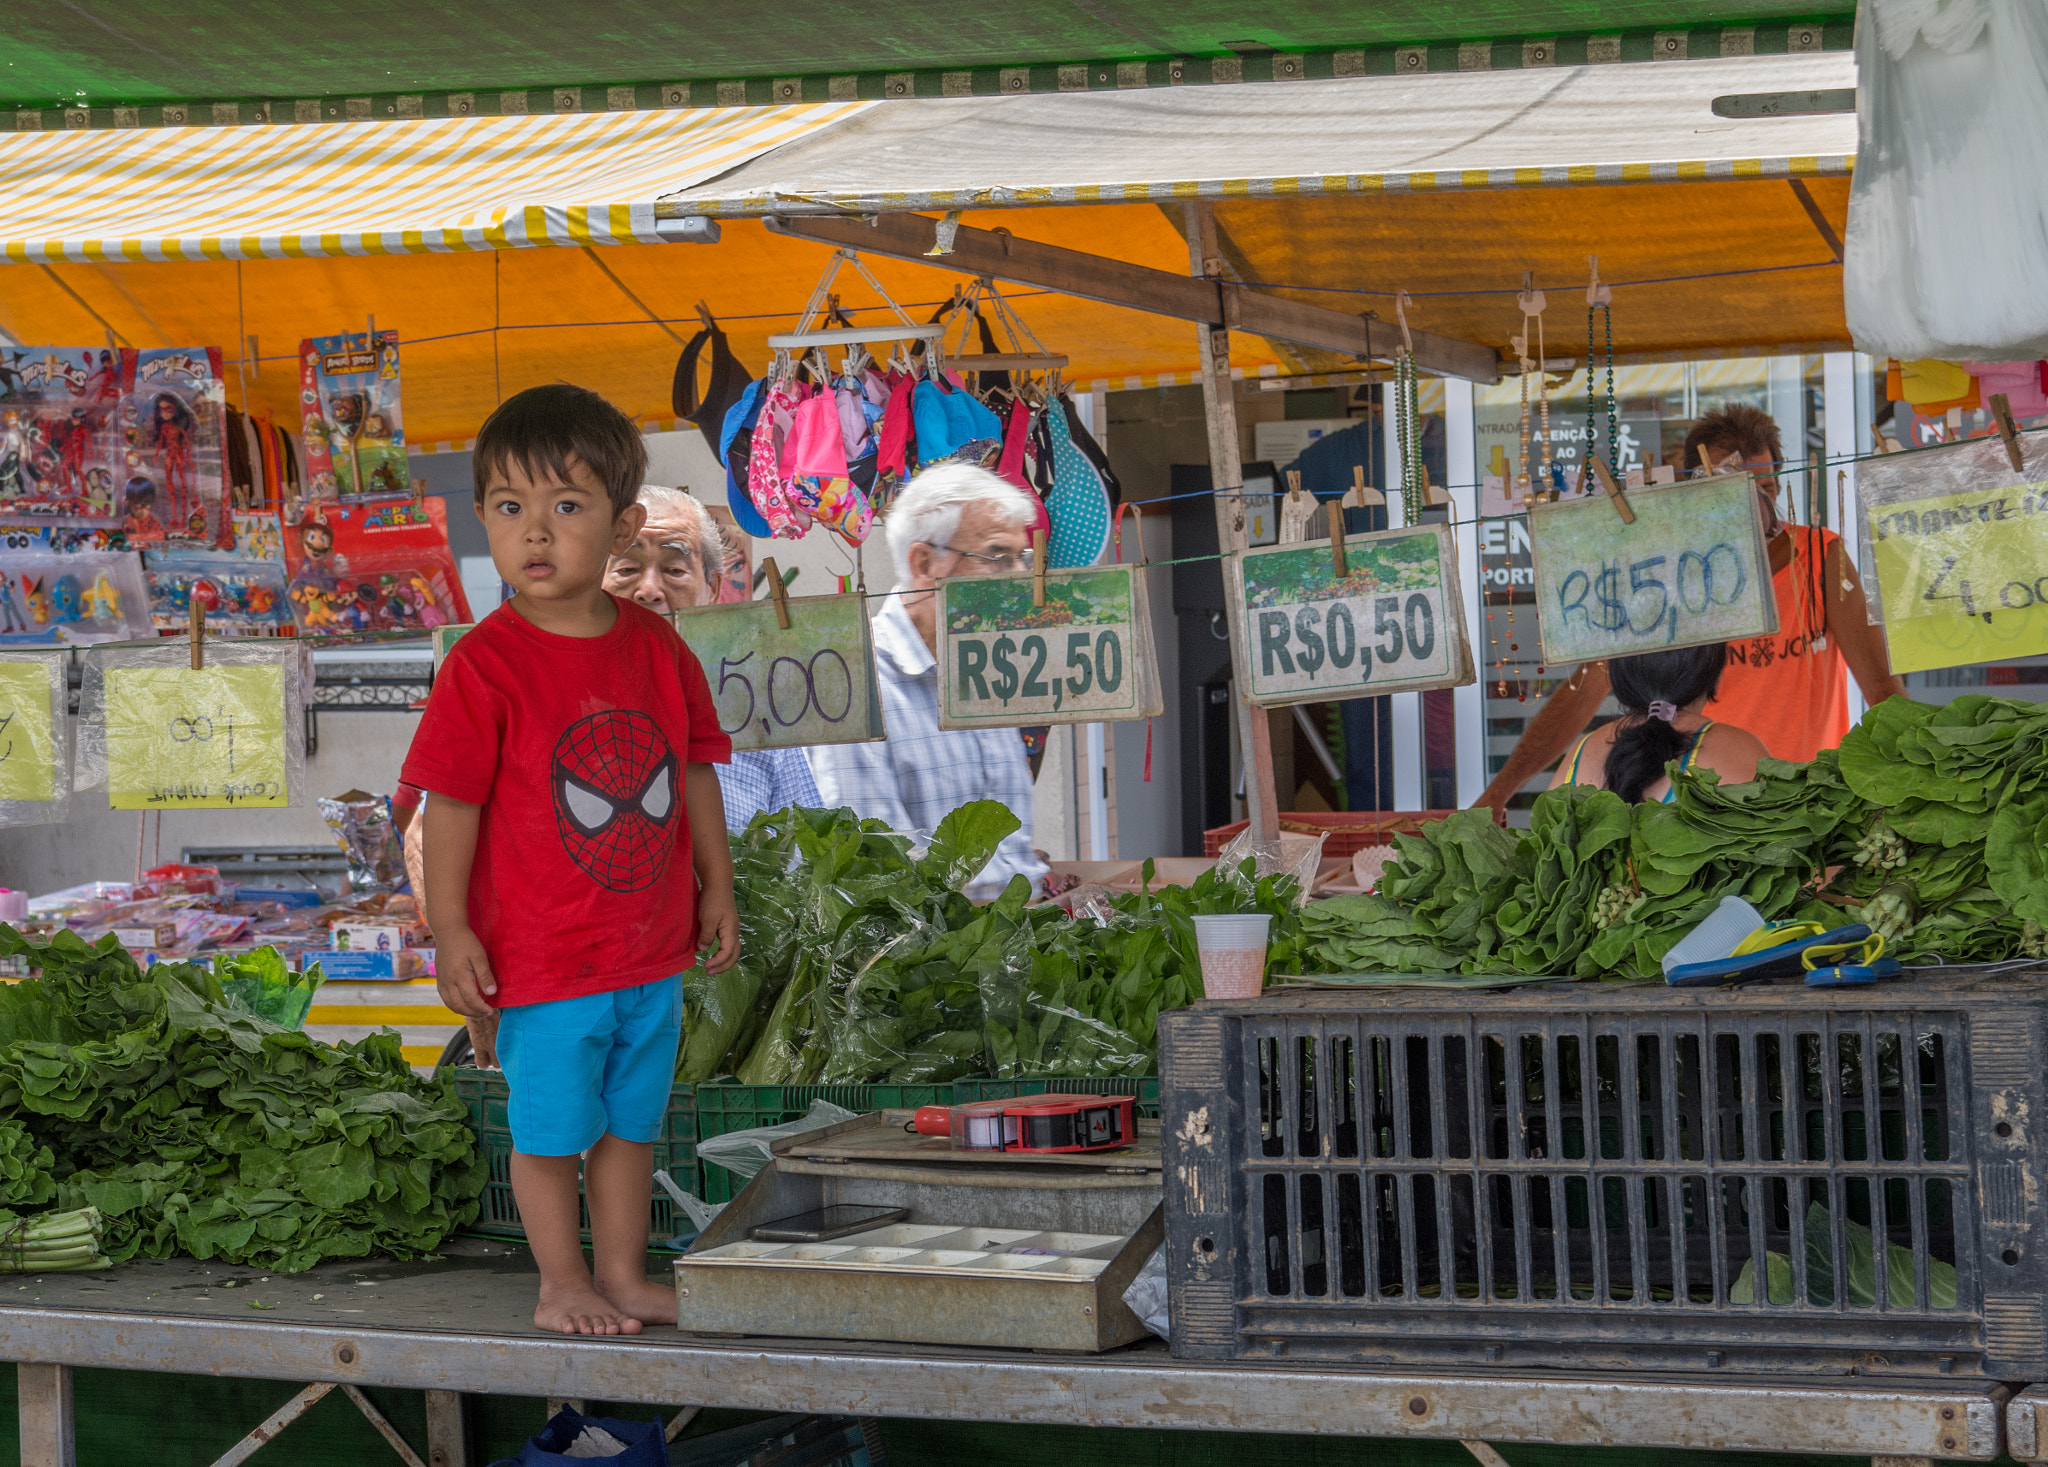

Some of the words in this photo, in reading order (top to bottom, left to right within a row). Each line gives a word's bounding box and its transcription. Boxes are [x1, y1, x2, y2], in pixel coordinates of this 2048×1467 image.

[327, 357, 350, 369] ANGR
[1478, 423, 1521, 435] NTRADA
[1533, 426, 1598, 443] AENÇÃO
[1556, 447, 1576, 459] AO
[363, 512, 429, 528] MARIO
[1556, 543, 1747, 645] R$5,00
[1258, 593, 1435, 682] R$0,50
[958, 630, 1122, 711] R$2,50
[718, 649, 852, 735] 5,00
